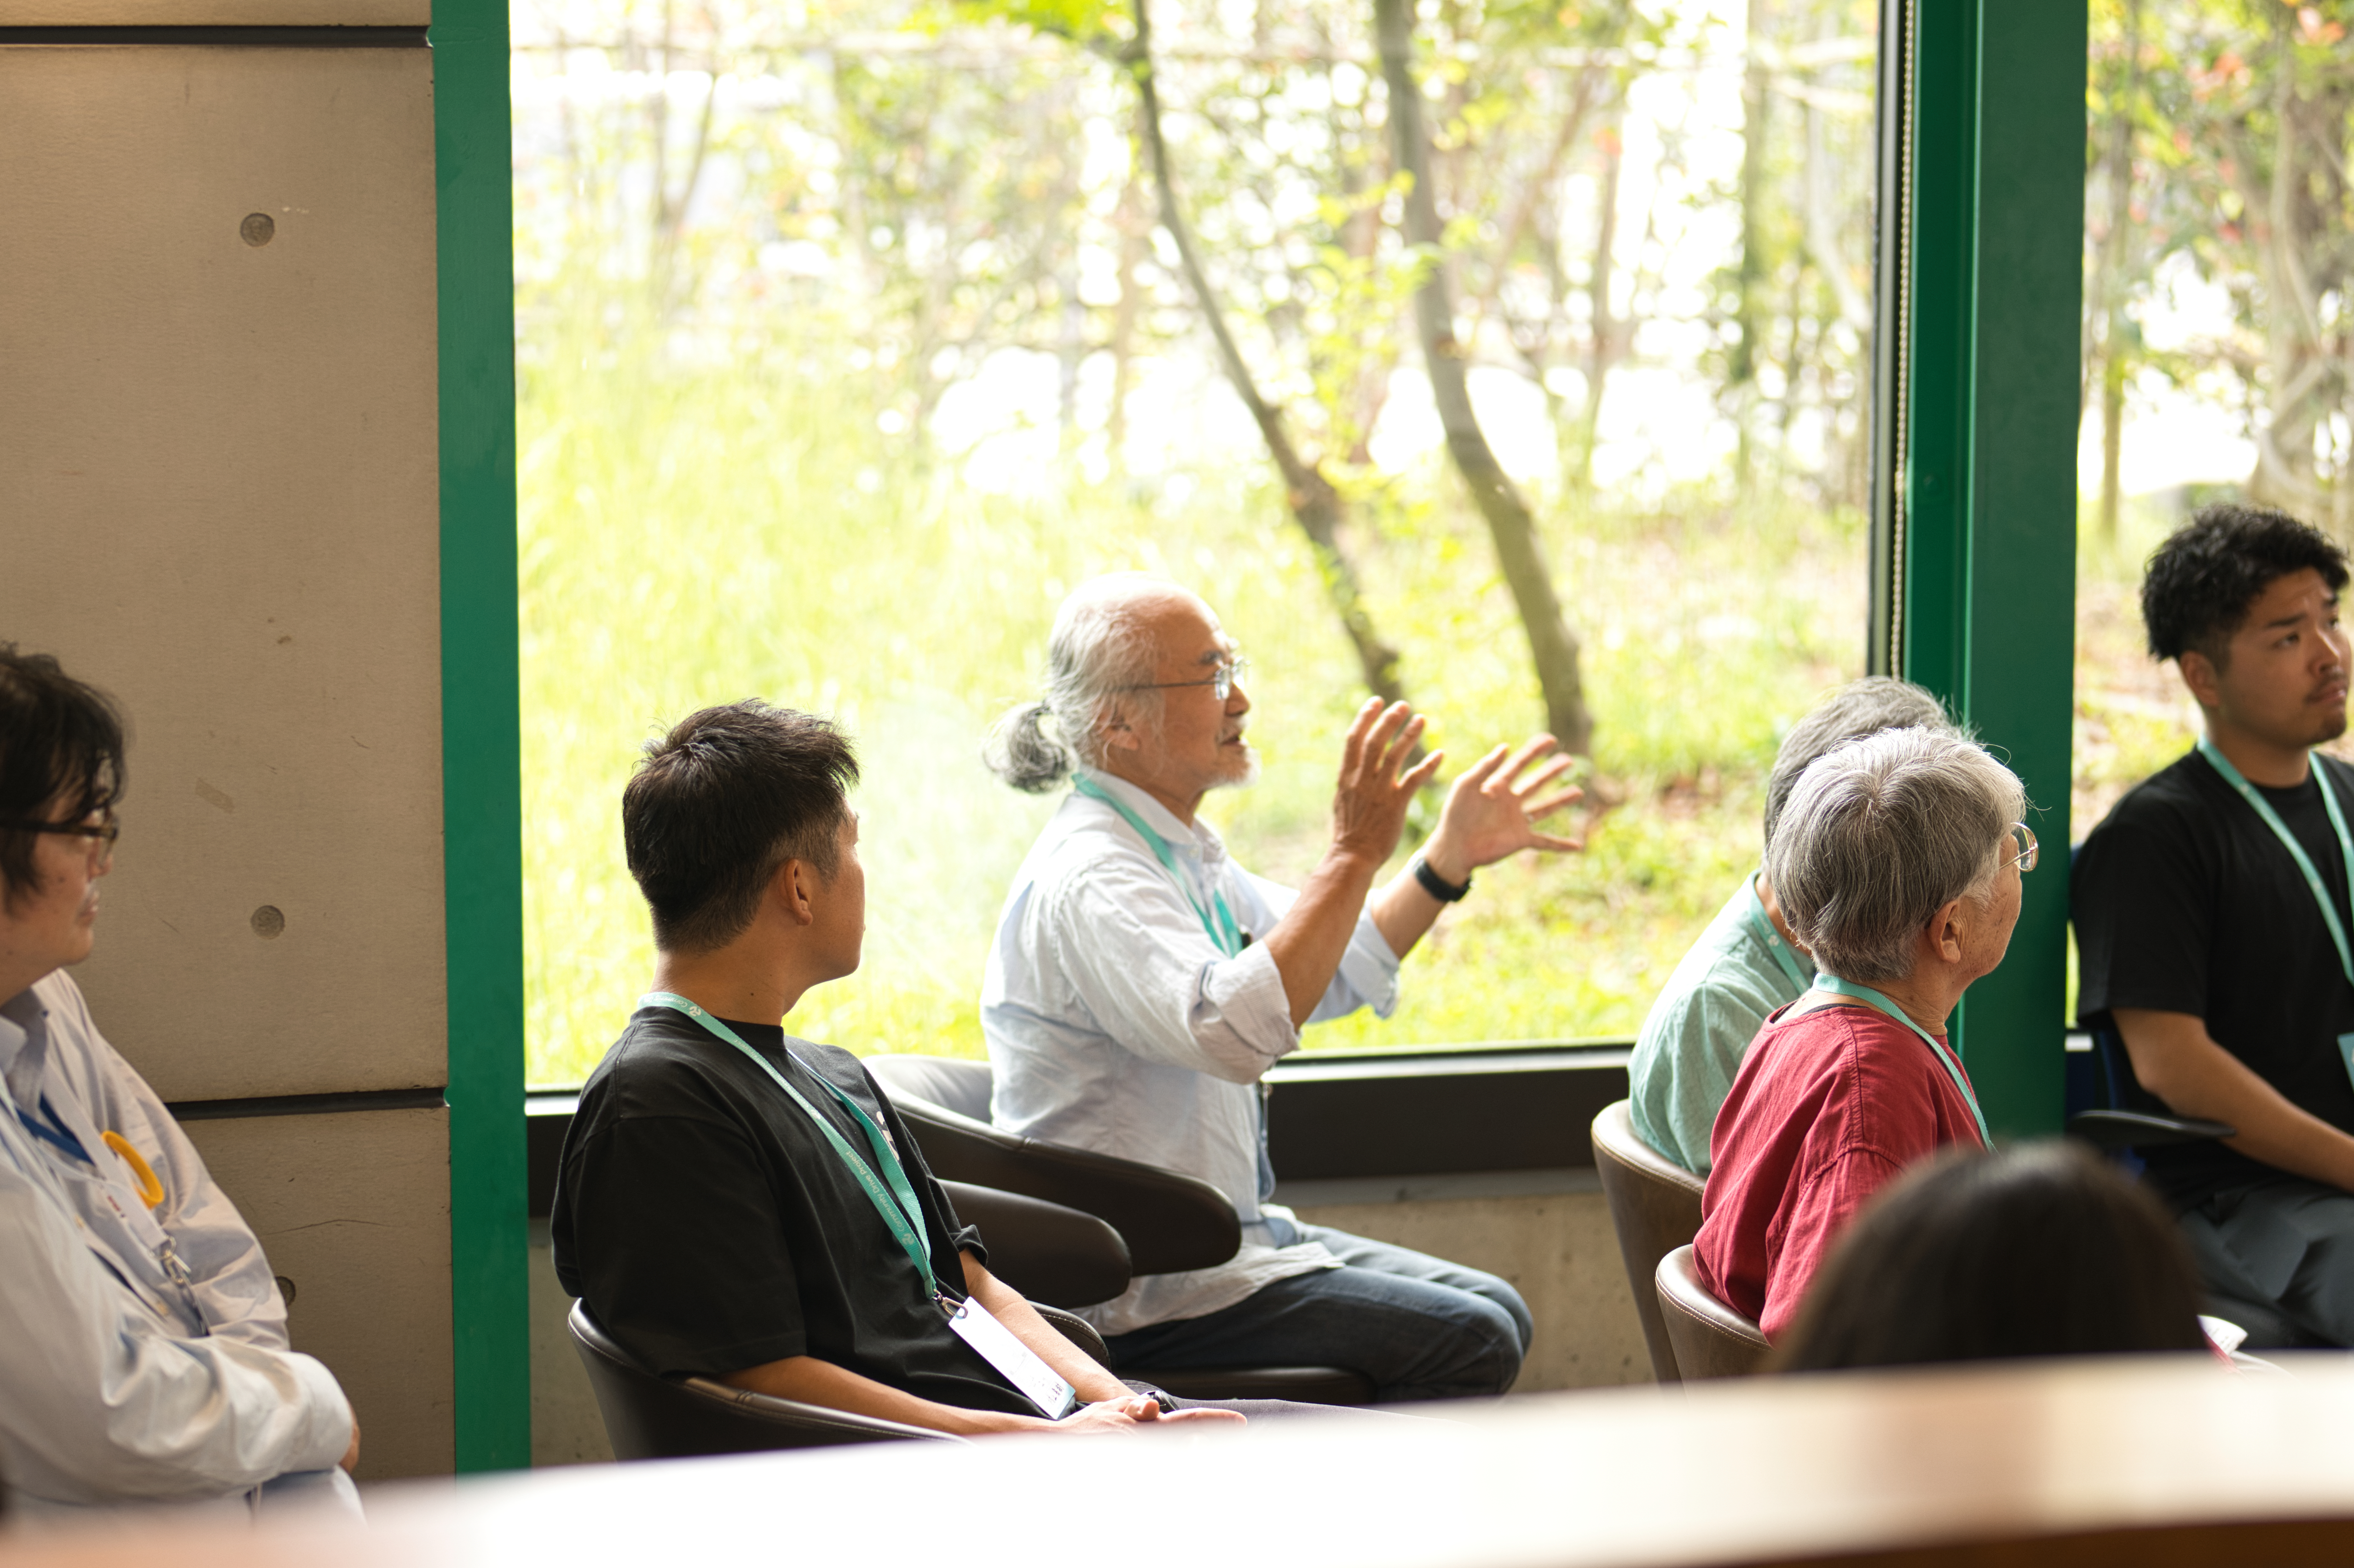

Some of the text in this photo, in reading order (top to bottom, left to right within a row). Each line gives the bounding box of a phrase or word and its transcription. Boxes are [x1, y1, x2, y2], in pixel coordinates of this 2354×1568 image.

[734, 1039, 758, 1058] Project
[846, 1151, 904, 1231] Community Drive Project
